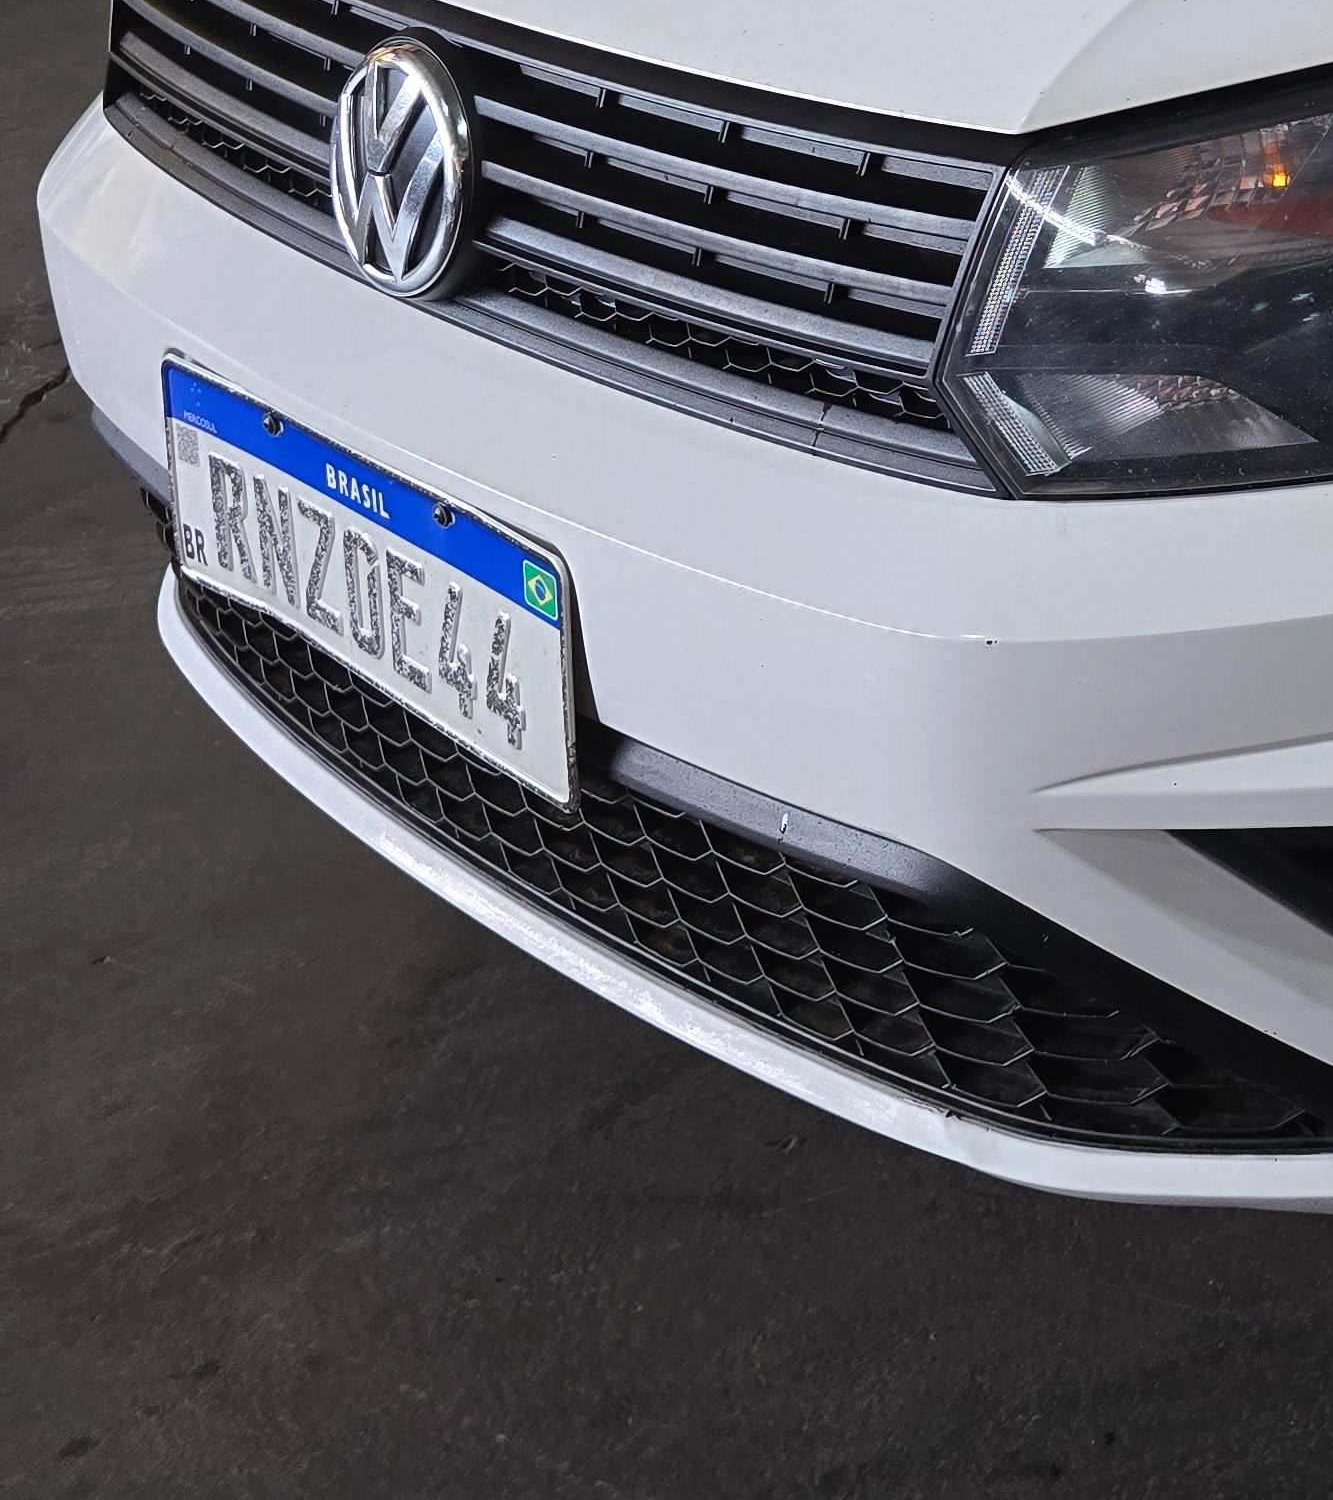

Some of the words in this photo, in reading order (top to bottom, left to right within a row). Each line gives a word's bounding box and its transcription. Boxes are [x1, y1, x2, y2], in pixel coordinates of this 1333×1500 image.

[183, 409, 218, 435] MERCOSUL
[324, 462, 391, 520] BRASIL
[182, 522, 208, 566] BR
